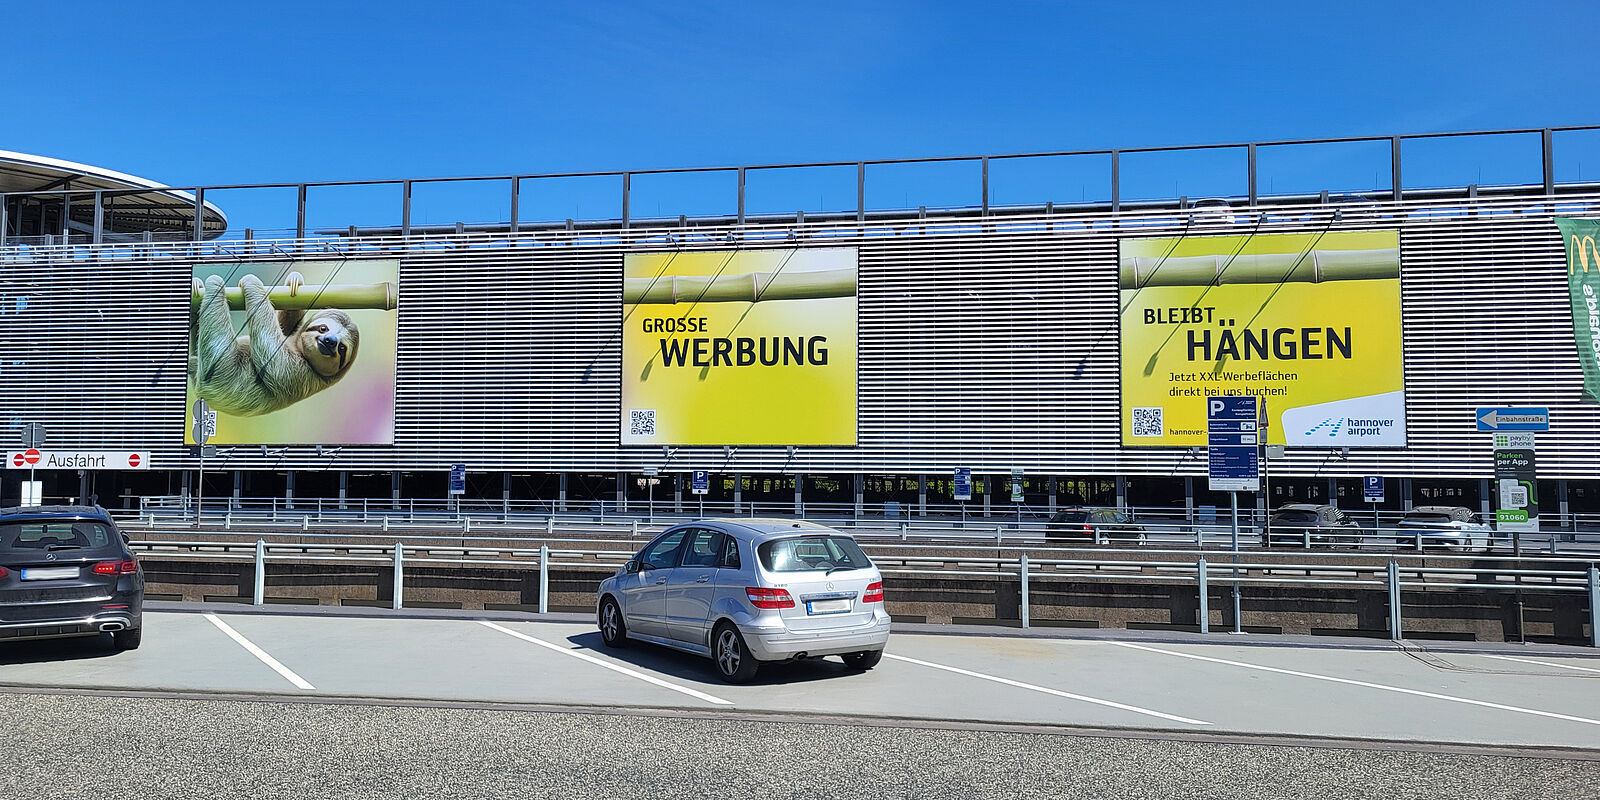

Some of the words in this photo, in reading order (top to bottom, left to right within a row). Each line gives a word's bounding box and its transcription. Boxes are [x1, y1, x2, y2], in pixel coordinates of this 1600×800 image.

[1144, 307, 1216, 324] BLEIBT
[642, 317, 708, 333] GROSSE
[1187, 319, 1352, 361] HÄNGEN
[660, 336, 828, 367] WERBUNG
[1168, 372, 1197, 382] Jetzt
[1199, 371, 1298, 381] XXL-Werbeflächen
[1169, 387, 1201, 397] direkt
[1204, 387, 1220, 397] bei
[1223, 388, 1244, 396] uns
[1245, 386, 1288, 396] buchen!
[1210, 400, 1225, 416] P
[1347, 417, 1394, 427] hannover
[1169, 428, 1208, 436] hannover-
[1347, 426, 1381, 437] airport
[47, 454, 106, 467] Ausfahrt
[697, 471, 704, 479] P
[1370, 477, 1378, 486] P
